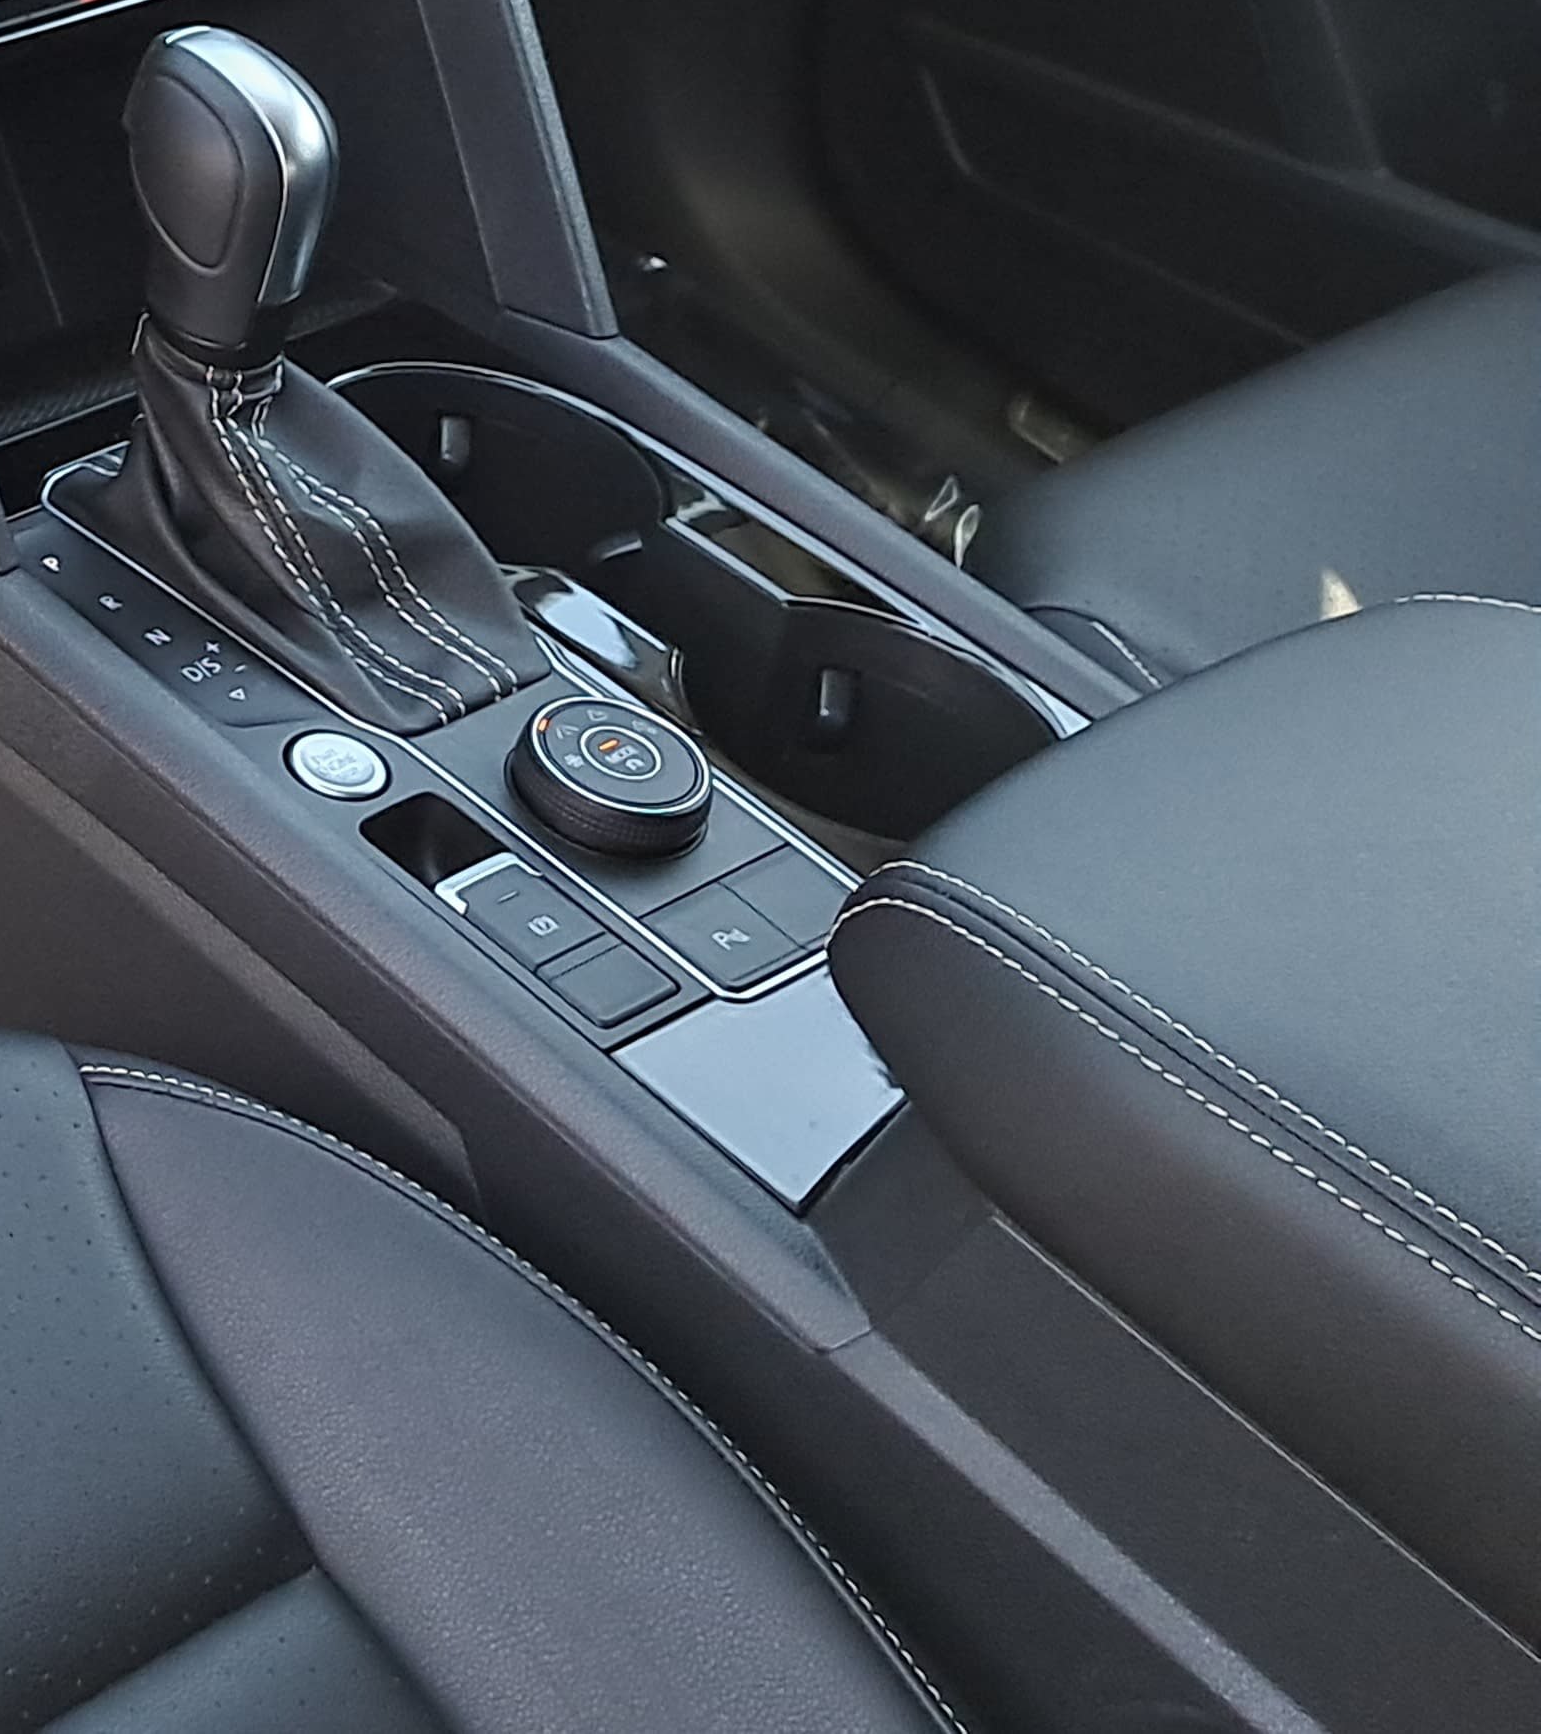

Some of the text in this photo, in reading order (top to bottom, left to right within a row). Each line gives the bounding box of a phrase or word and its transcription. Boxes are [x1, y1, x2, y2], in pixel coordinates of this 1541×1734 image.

[42, 555, 61, 573] P
[100, 594, 124, 611] R
[145, 628, 172, 645] N
[181, 658, 222, 683] D/S
